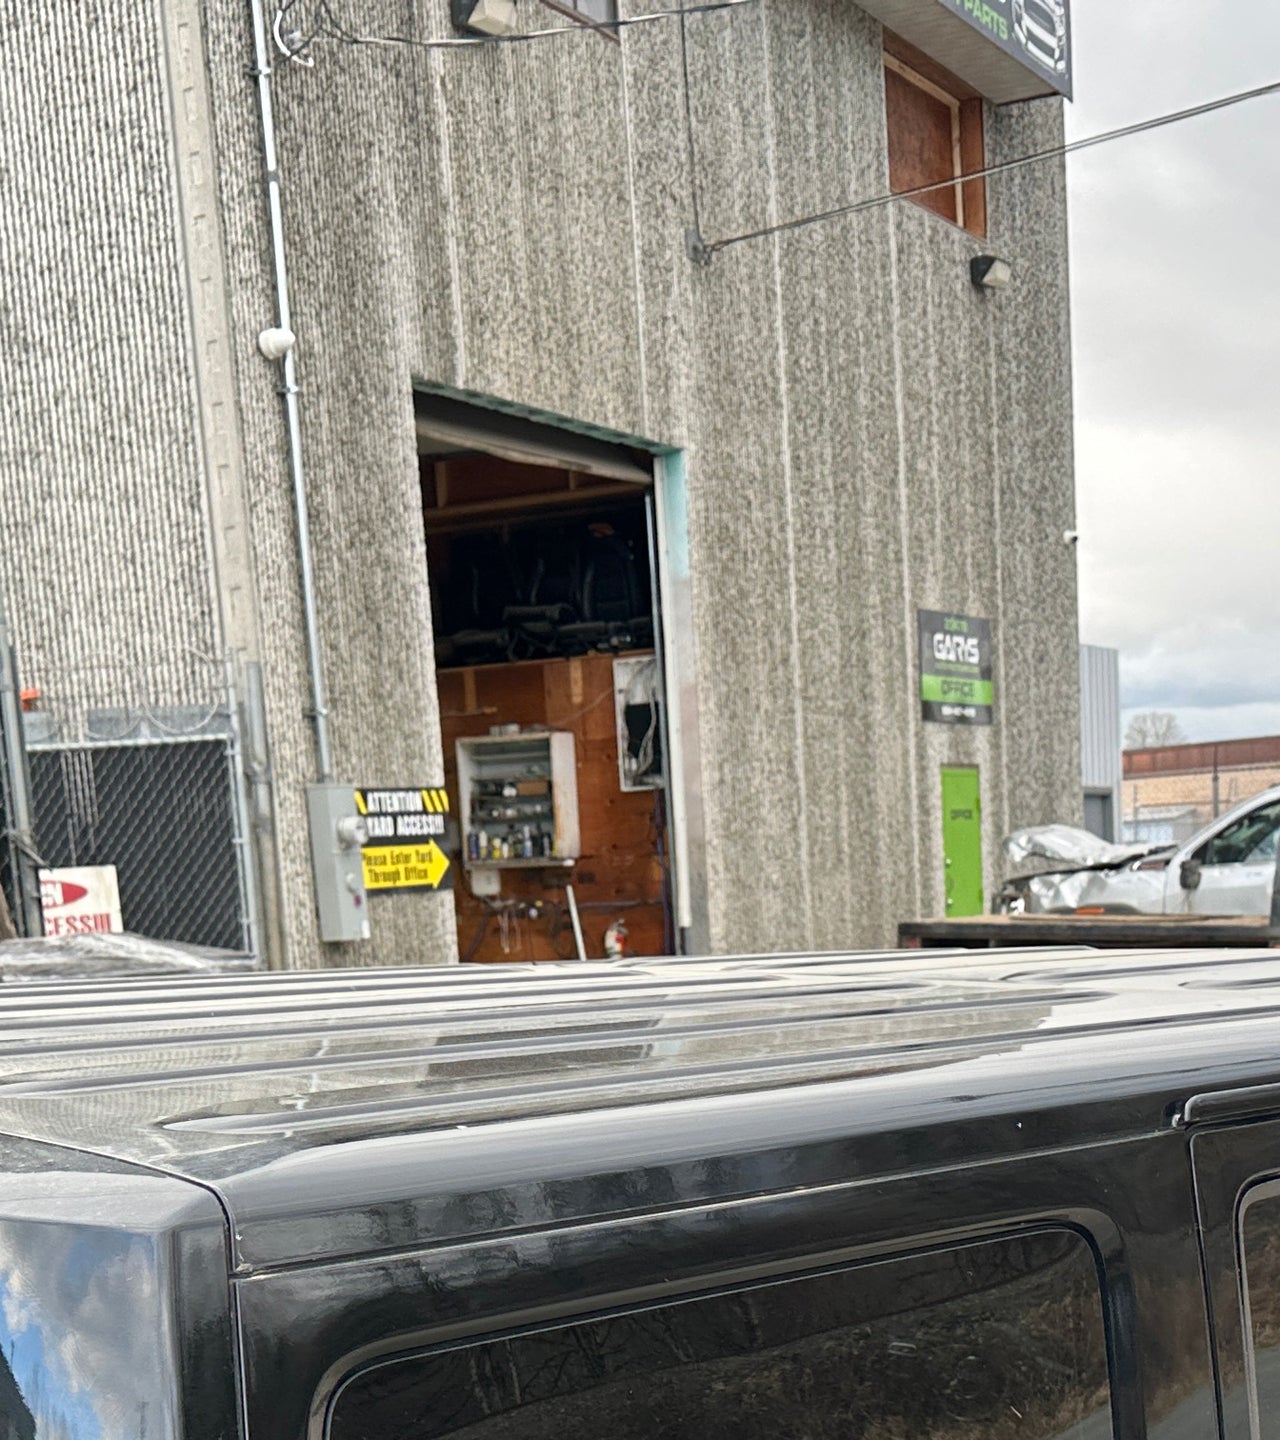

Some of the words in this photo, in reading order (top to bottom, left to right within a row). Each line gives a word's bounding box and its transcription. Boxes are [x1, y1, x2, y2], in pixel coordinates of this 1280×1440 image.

[367, 792, 423, 813] ATTENTION
[390, 850, 412, 866] Enter
[415, 849, 433, 864] Yard
[368, 869, 401, 885] Through
[404, 866, 428, 881] Office
